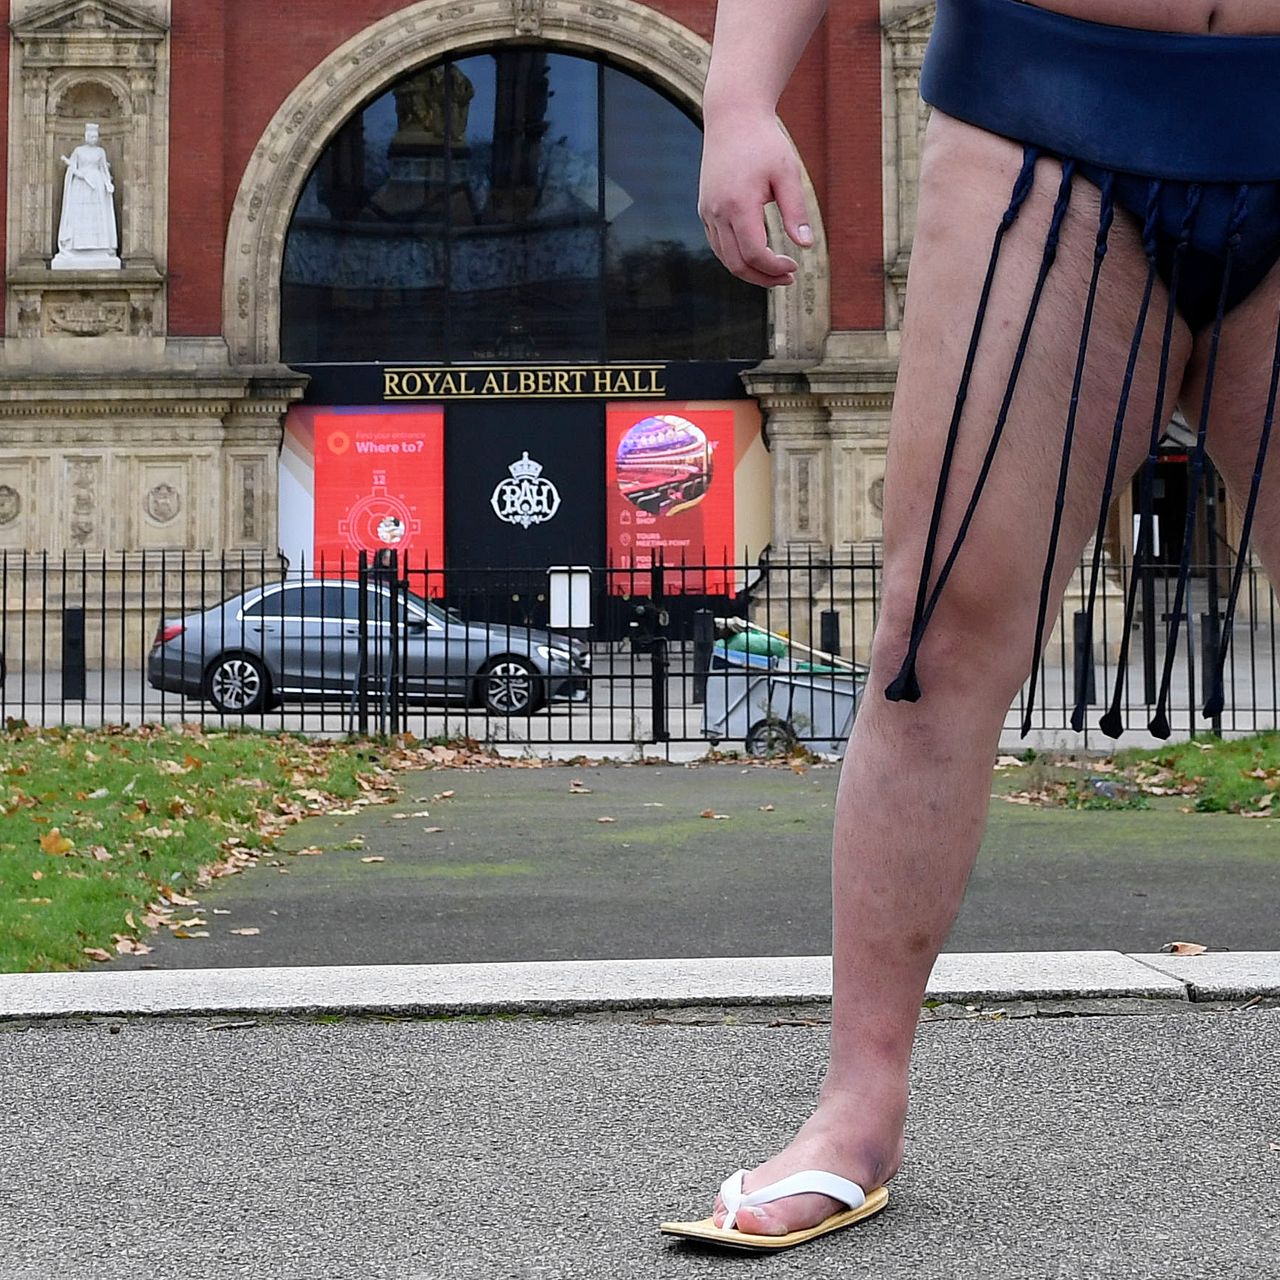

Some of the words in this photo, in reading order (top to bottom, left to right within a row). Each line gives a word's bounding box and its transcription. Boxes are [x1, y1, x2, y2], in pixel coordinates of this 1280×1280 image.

[384, 372, 476, 395] ROYAL
[481, 371, 588, 394] ALBERT
[593, 370, 666, 393] HALL
[356, 441, 400, 453] Where
[402, 440, 424, 453] to?
[373, 475, 386, 486] 12
